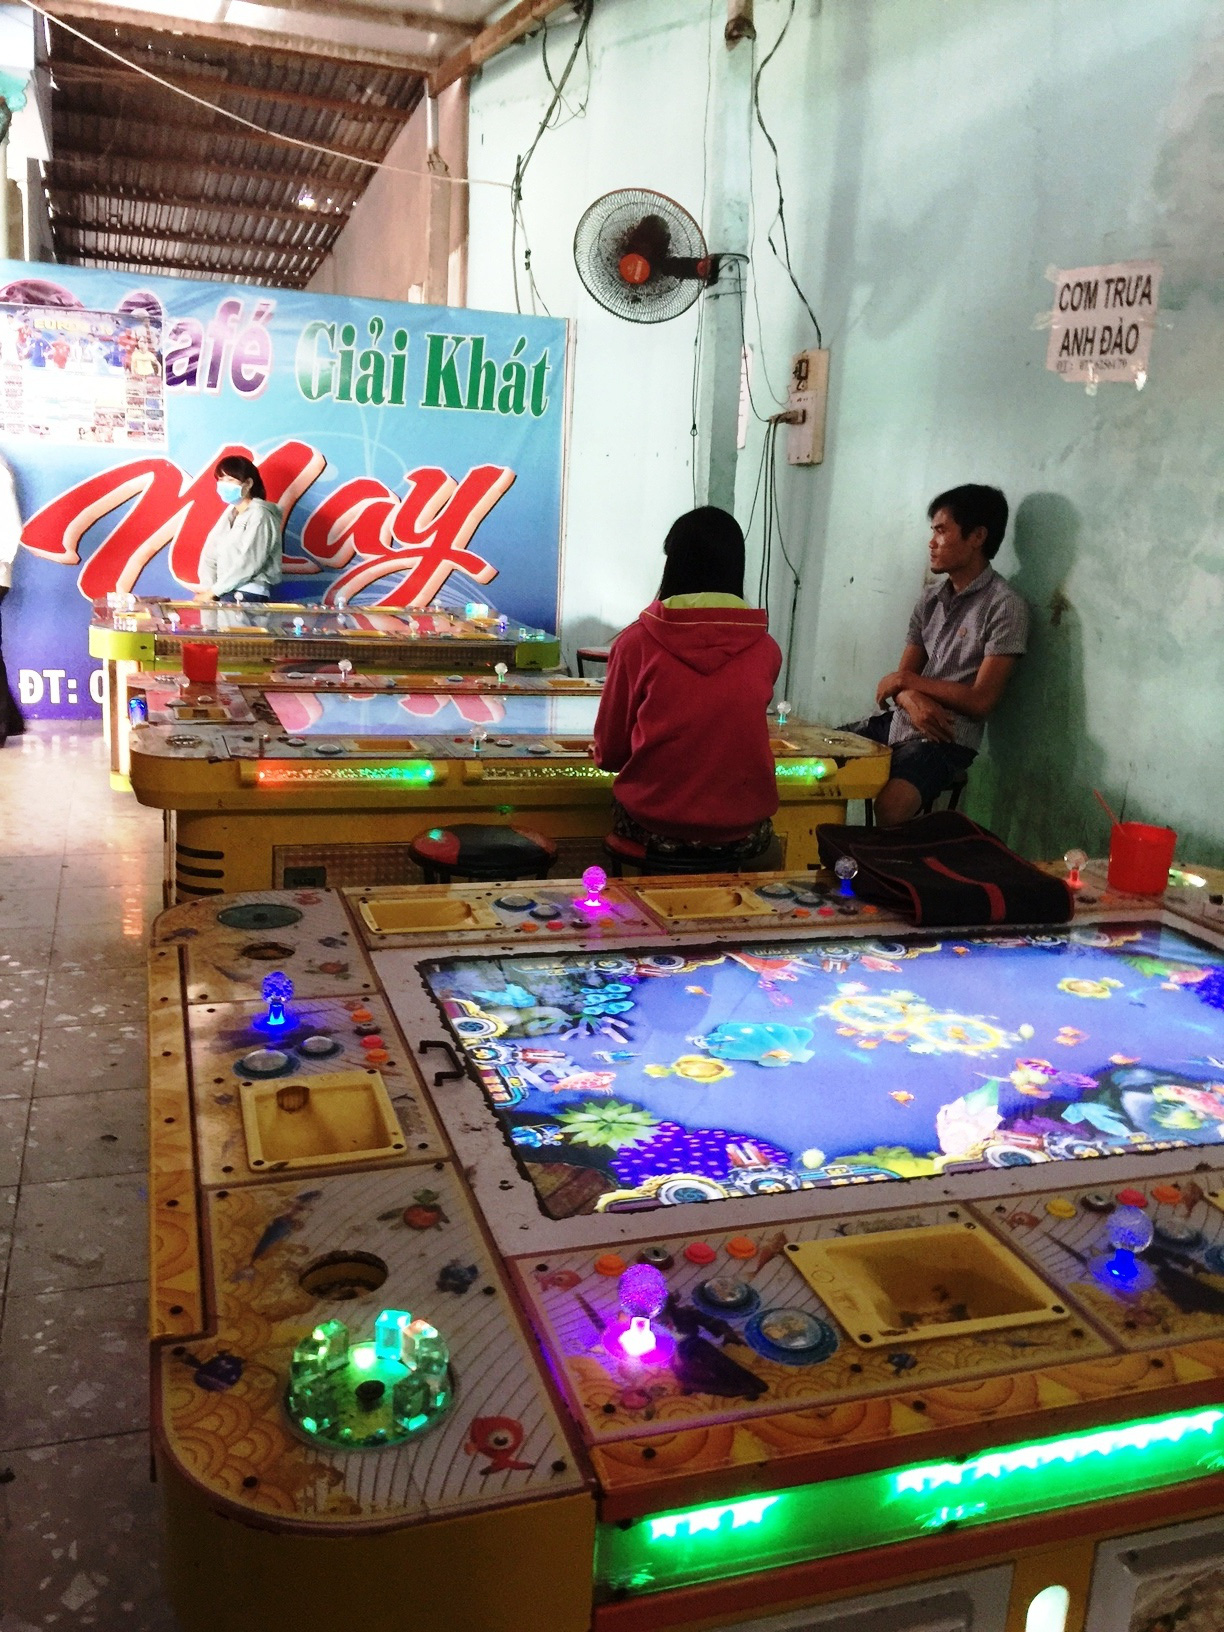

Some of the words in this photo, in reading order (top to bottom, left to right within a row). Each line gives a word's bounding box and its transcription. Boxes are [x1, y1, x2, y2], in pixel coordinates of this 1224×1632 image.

[117, 292, 275, 398] afé
[299, 317, 408, 405] Giải
[421, 333, 551, 417] Khát
[1059, 326, 1097, 357] ANH
[18, 669, 78, 704] ĐT:
